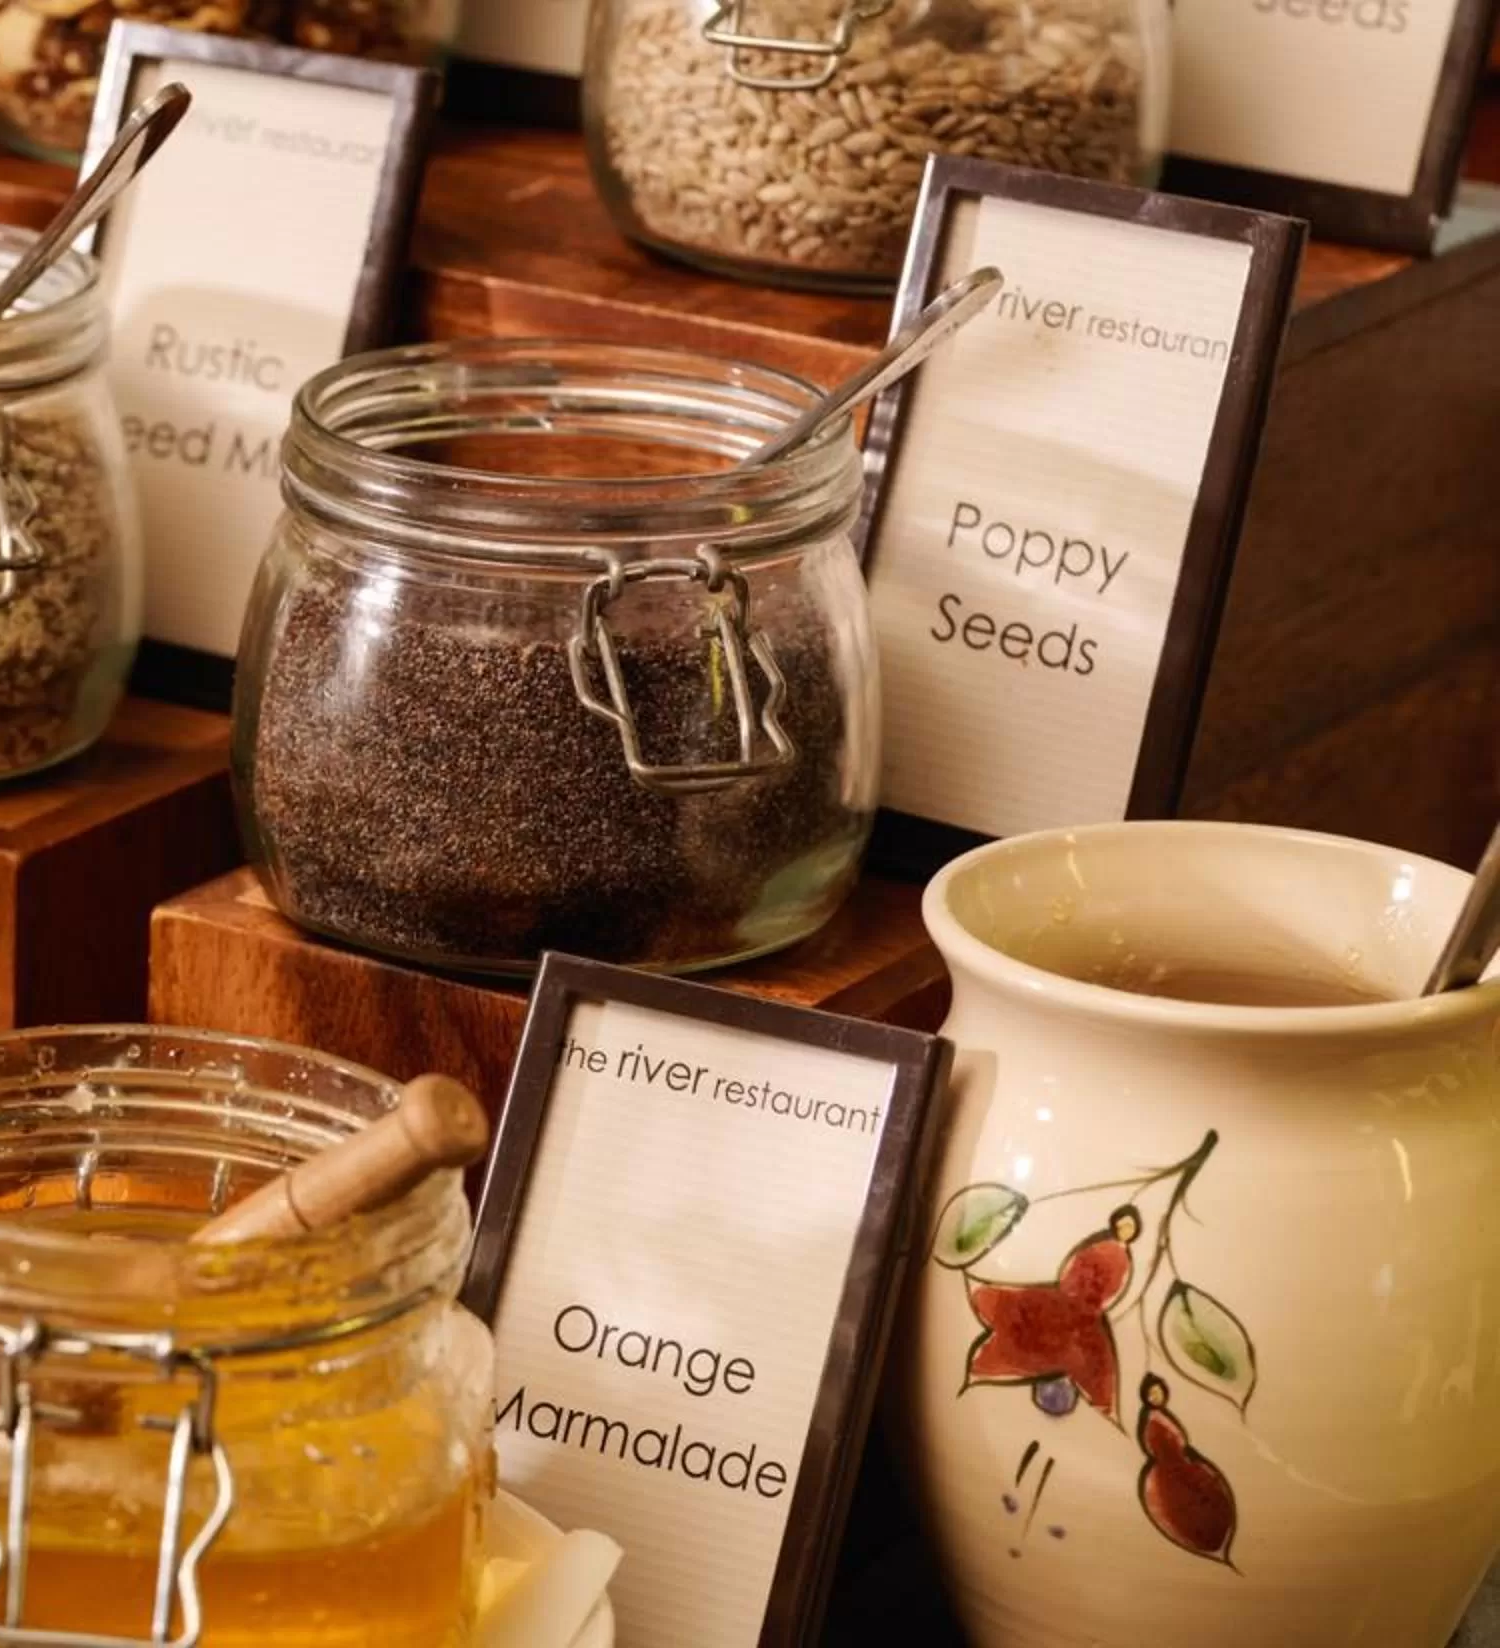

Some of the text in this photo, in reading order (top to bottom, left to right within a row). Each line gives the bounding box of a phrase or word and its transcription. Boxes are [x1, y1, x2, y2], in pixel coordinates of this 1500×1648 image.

[145, 323, 286, 392] Rustic
[997, 287, 1229, 362] river restauran
[120, 415, 217, 466] eed
[946, 501, 1130, 594] Poppy
[930, 594, 1098, 676] Seeds
[616, 1044, 709, 1094] river
[712, 1076, 882, 1133] restaurant
[553, 1305, 756, 1396] Orange
